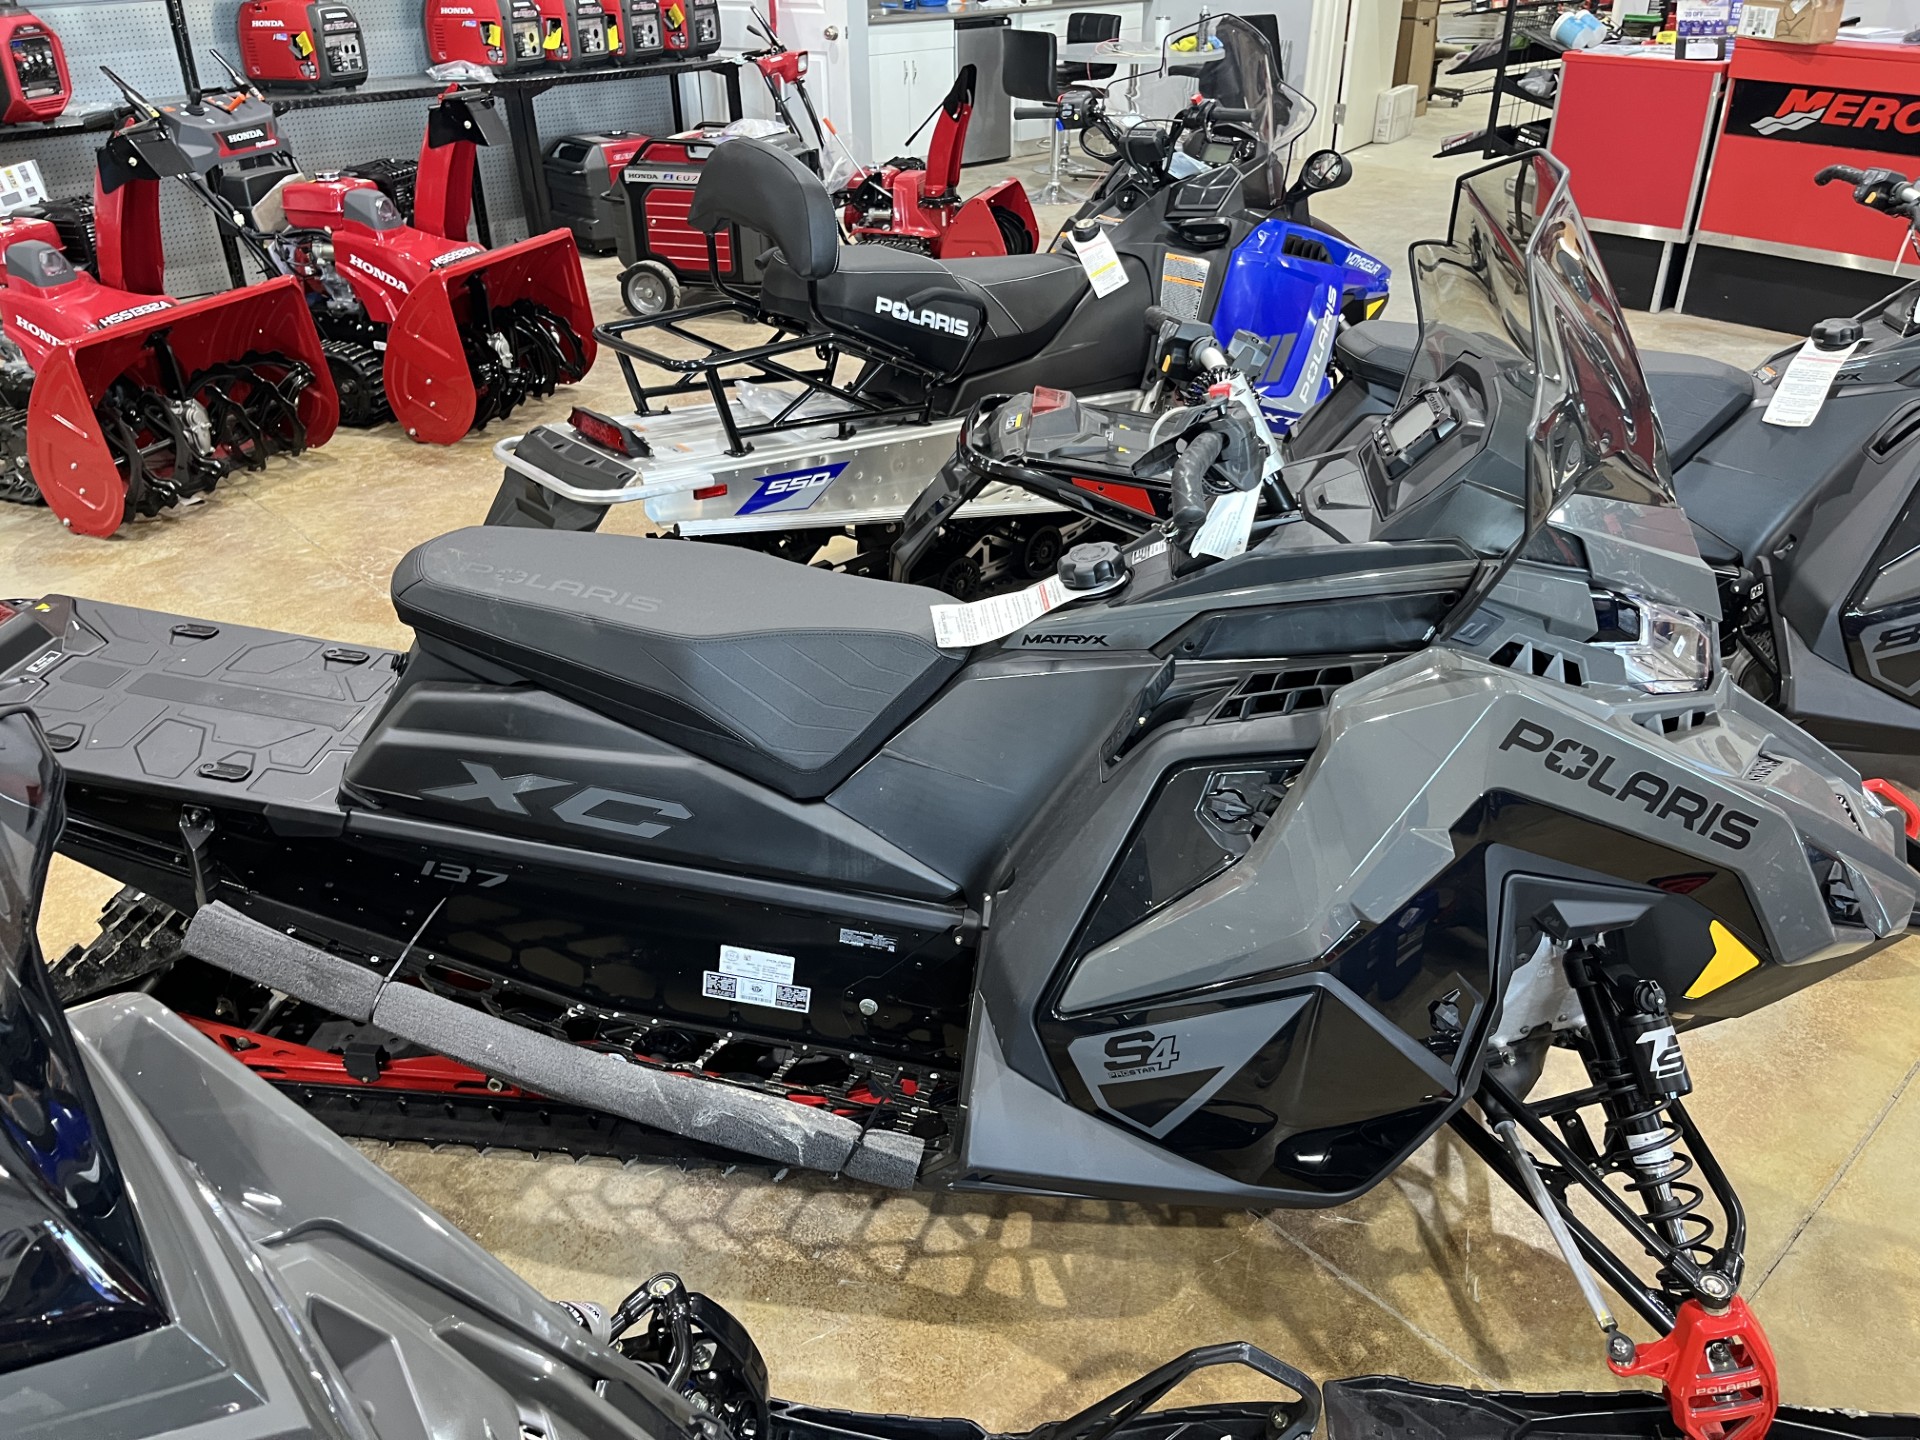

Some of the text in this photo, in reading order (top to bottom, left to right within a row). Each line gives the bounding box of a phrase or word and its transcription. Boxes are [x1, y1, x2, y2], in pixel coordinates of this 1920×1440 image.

[440, 7, 474, 15] HONDA
[1774, 88, 1920, 134] MERC
[227, 129, 265, 143] HONDA
[349, 254, 410, 295] HONDA
[1345, 252, 1381, 275] VOYAGEUR
[875, 296, 969, 337] POLARIS
[1299, 285, 1337, 404] POLARIS
[462, 561, 663, 614] POLARIS
[1021, 634, 1109, 648] MATRYX
[420, 759, 695, 839] XC
[1498, 718, 1759, 850] POLARIS
[420, 860, 509, 889] 137
[1103, 1030, 1180, 1071] S4
[1107, 1066, 1156, 1079] PROSTAR
[1696, 1378, 1760, 1396] POLARIS
